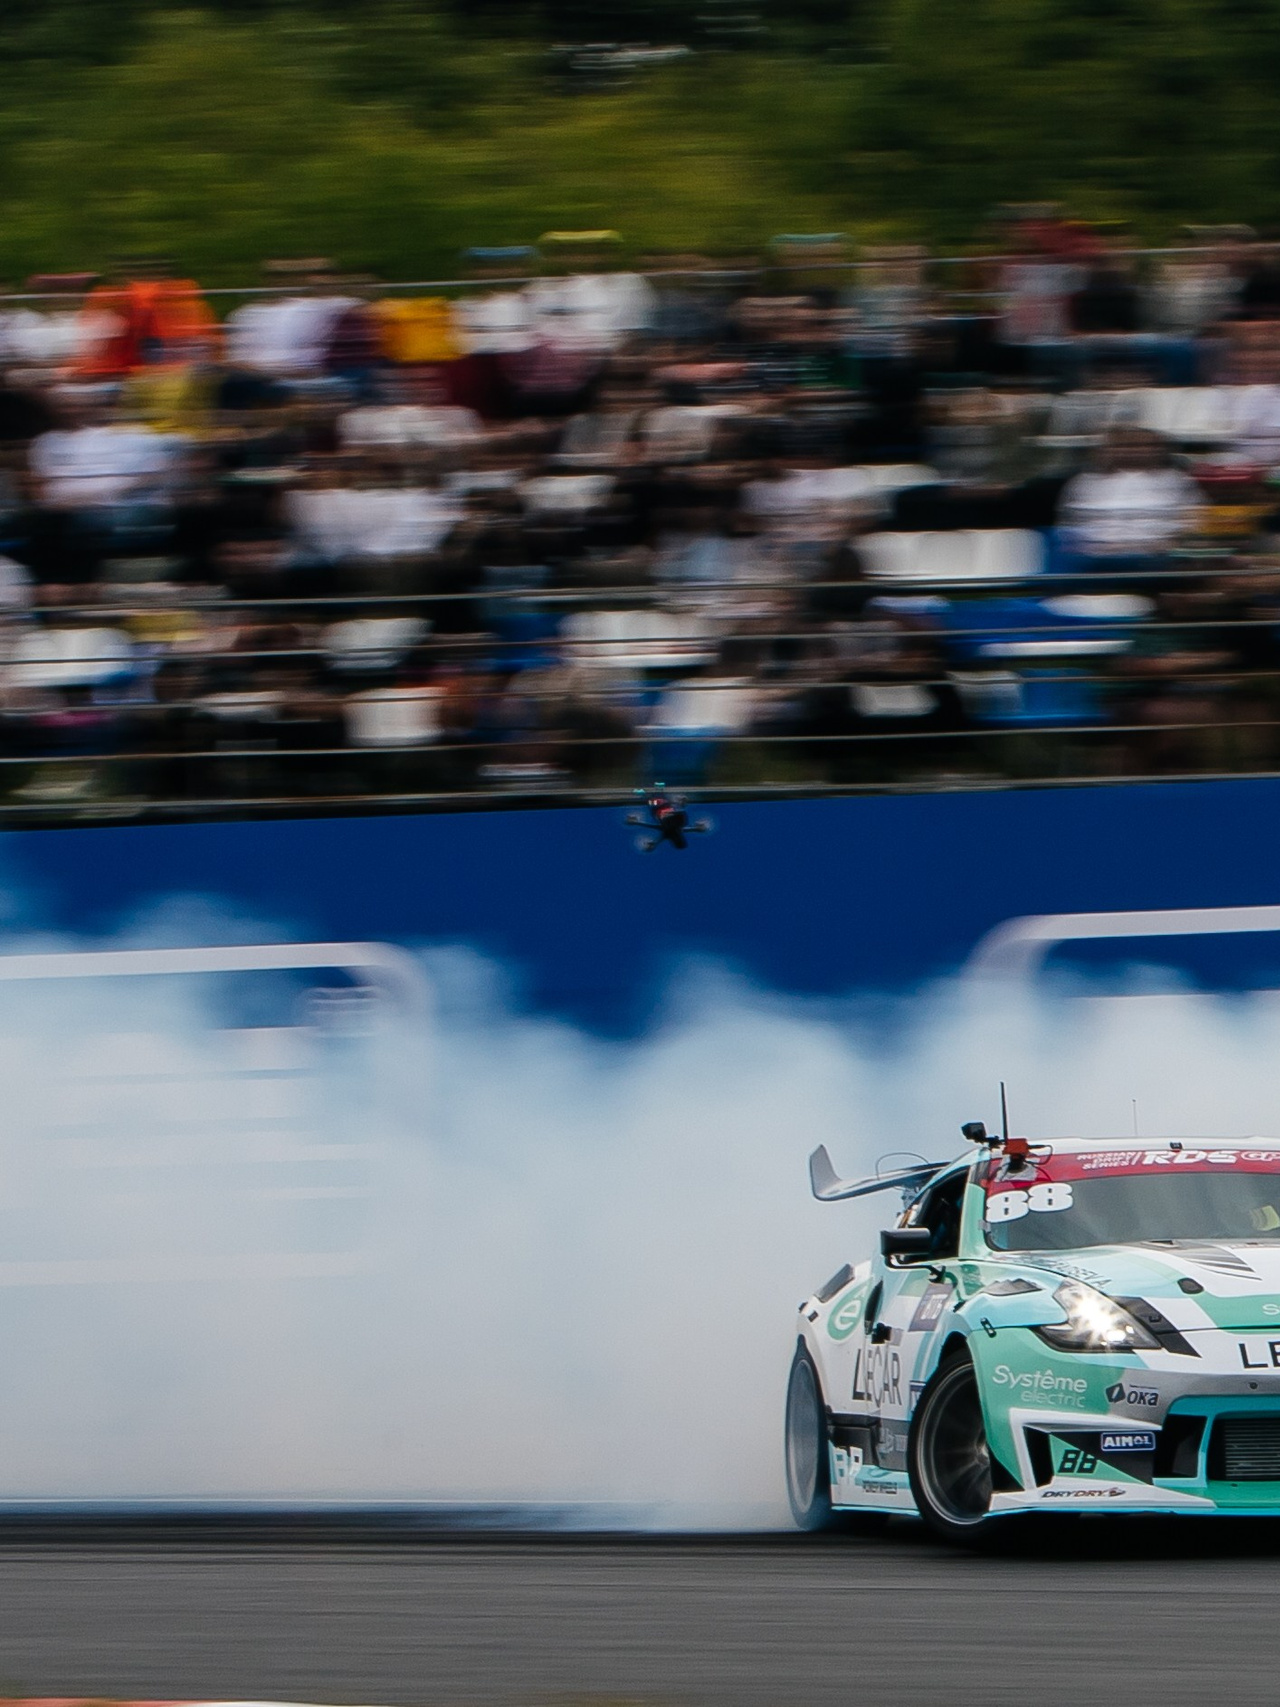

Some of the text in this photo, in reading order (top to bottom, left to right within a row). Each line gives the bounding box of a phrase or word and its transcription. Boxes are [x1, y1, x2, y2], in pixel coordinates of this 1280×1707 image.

[1142, 1150, 1241, 1165] RDS
[985, 1182, 1074, 1224] 88
[992, 1364, 1088, 1393] Système
[1020, 1389, 1086, 1408] electric
